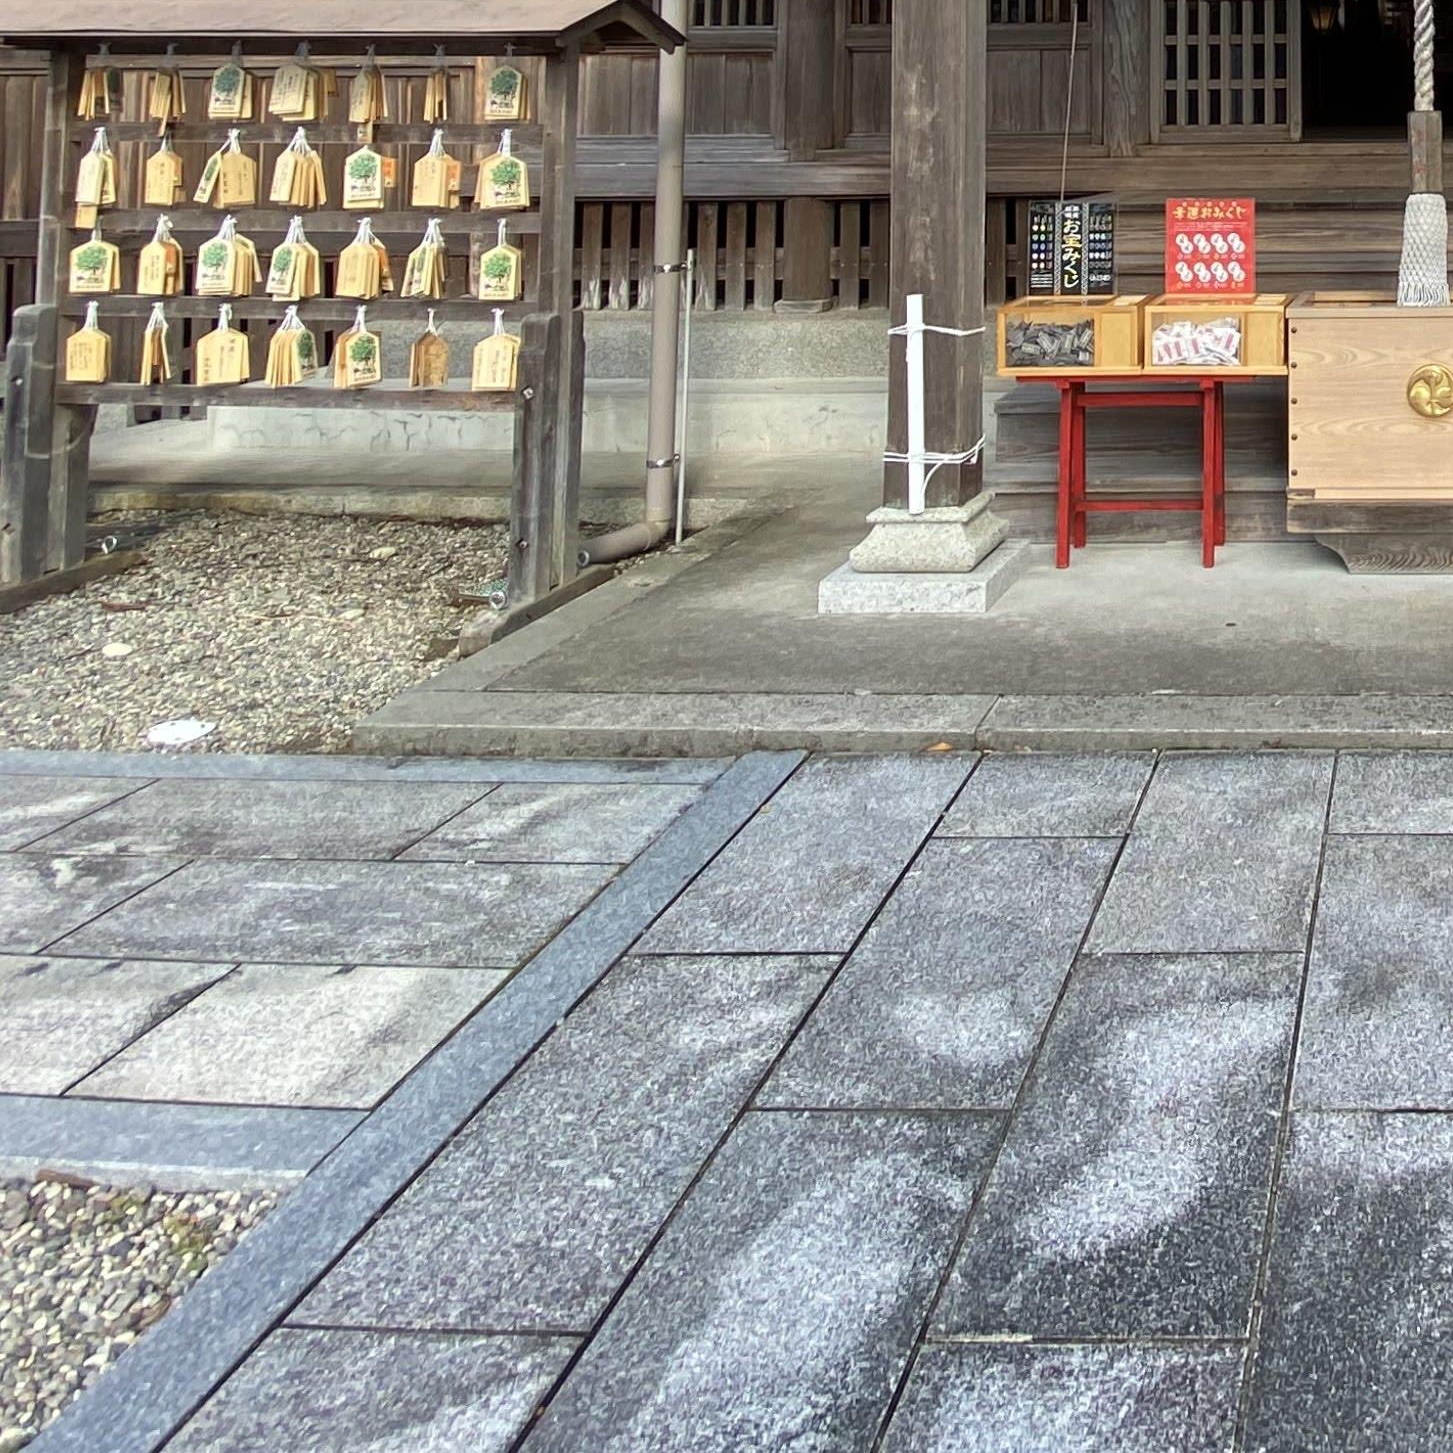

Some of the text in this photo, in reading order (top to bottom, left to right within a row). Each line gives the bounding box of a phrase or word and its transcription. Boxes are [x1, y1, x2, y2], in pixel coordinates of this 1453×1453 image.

[1061, 219, 1083, 288] お宝みくじ
